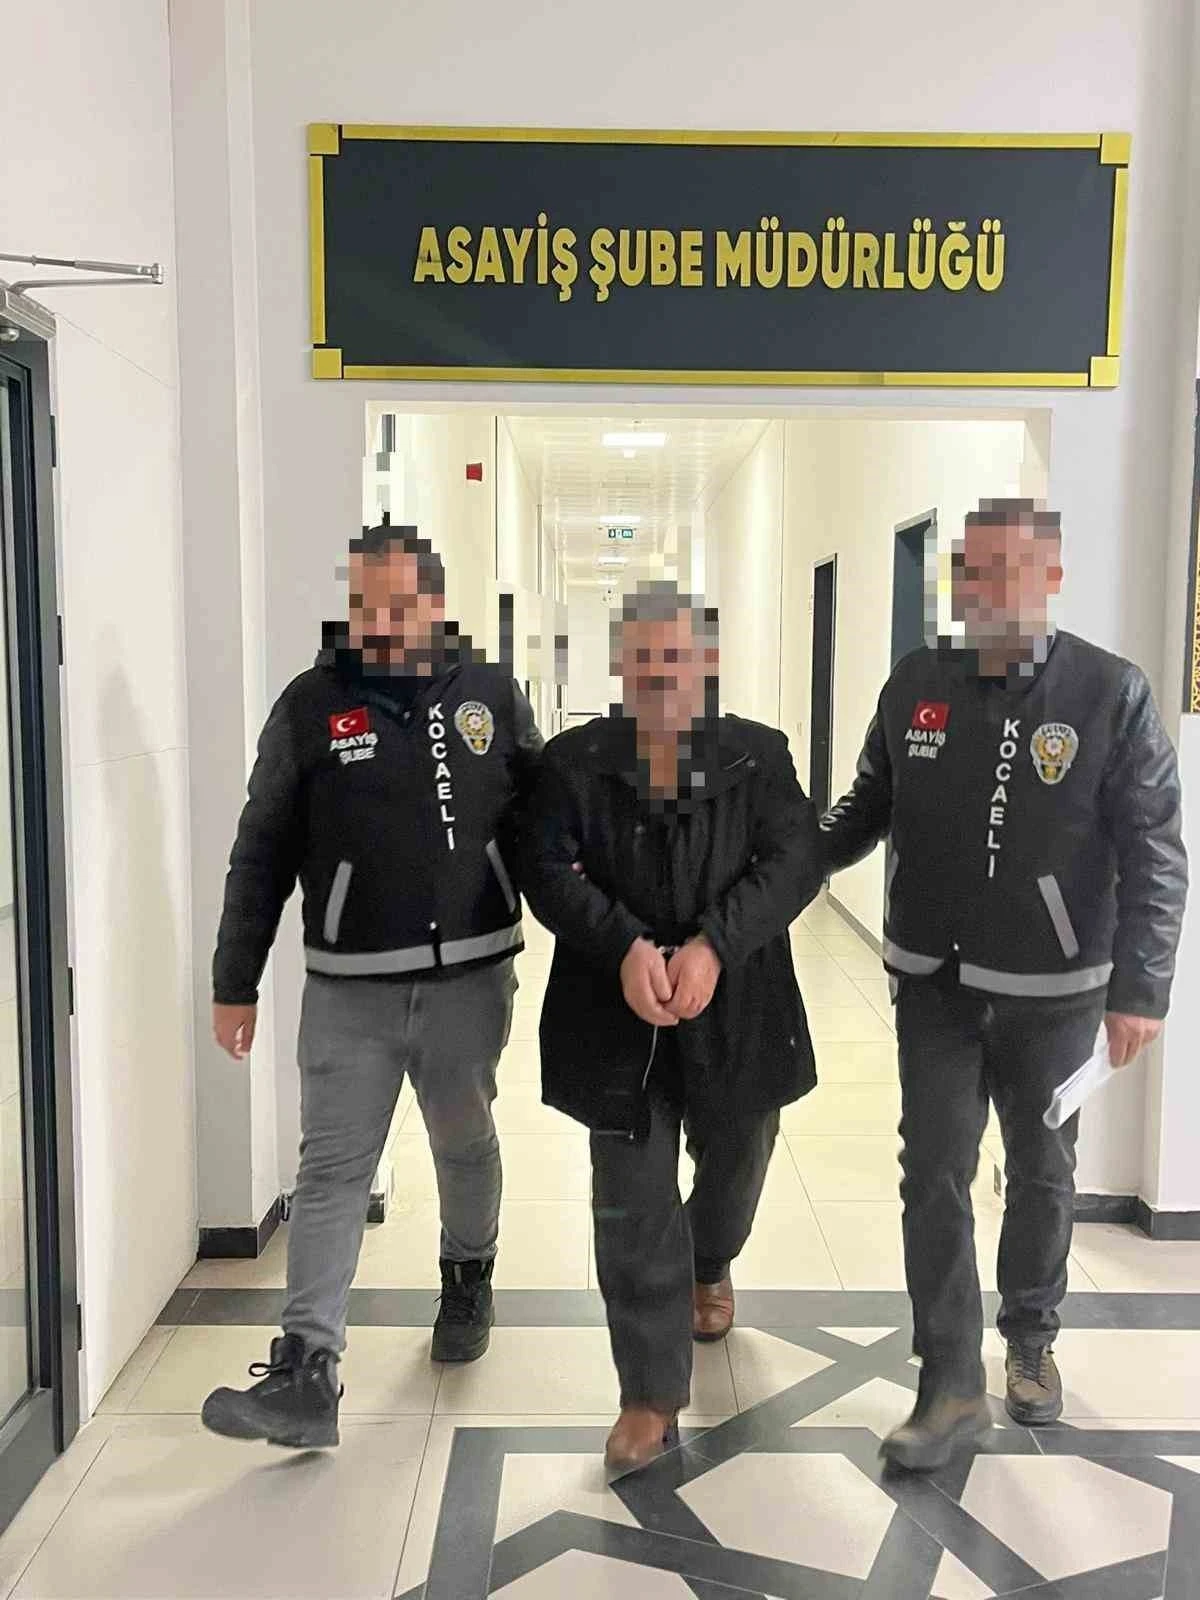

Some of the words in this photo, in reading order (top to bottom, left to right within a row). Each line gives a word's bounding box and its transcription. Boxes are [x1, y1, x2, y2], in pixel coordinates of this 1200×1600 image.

[414, 213, 579, 302] ASAYİŞ
[590, 228, 704, 302] ŞUBE
[715, 216, 1005, 291] MÜDÜRLÜĞÜ
